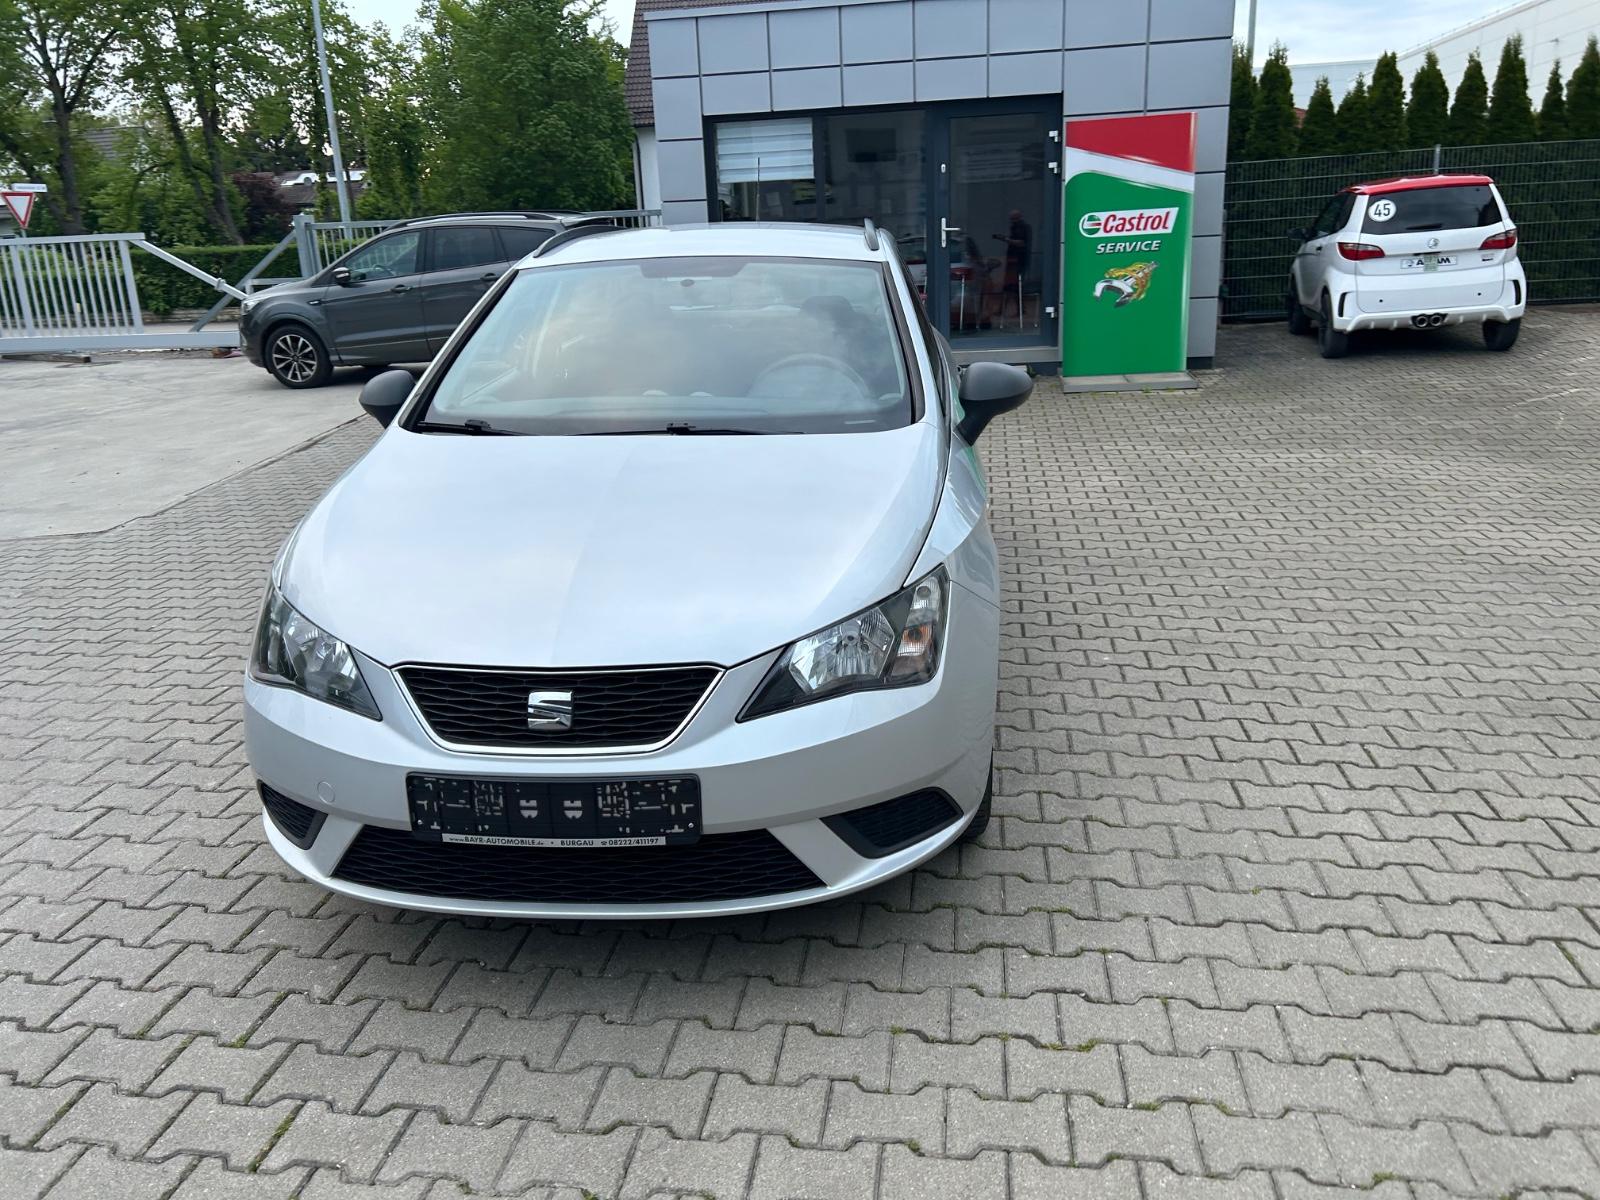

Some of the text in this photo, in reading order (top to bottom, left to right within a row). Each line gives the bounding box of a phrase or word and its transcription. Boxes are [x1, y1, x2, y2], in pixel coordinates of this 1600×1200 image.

[1374, 203, 1391, 217] 45
[1103, 211, 1170, 233] Castrol
[1096, 240, 1161, 254] SERVICE
[608, 838, 659, 846] 08222/411197
